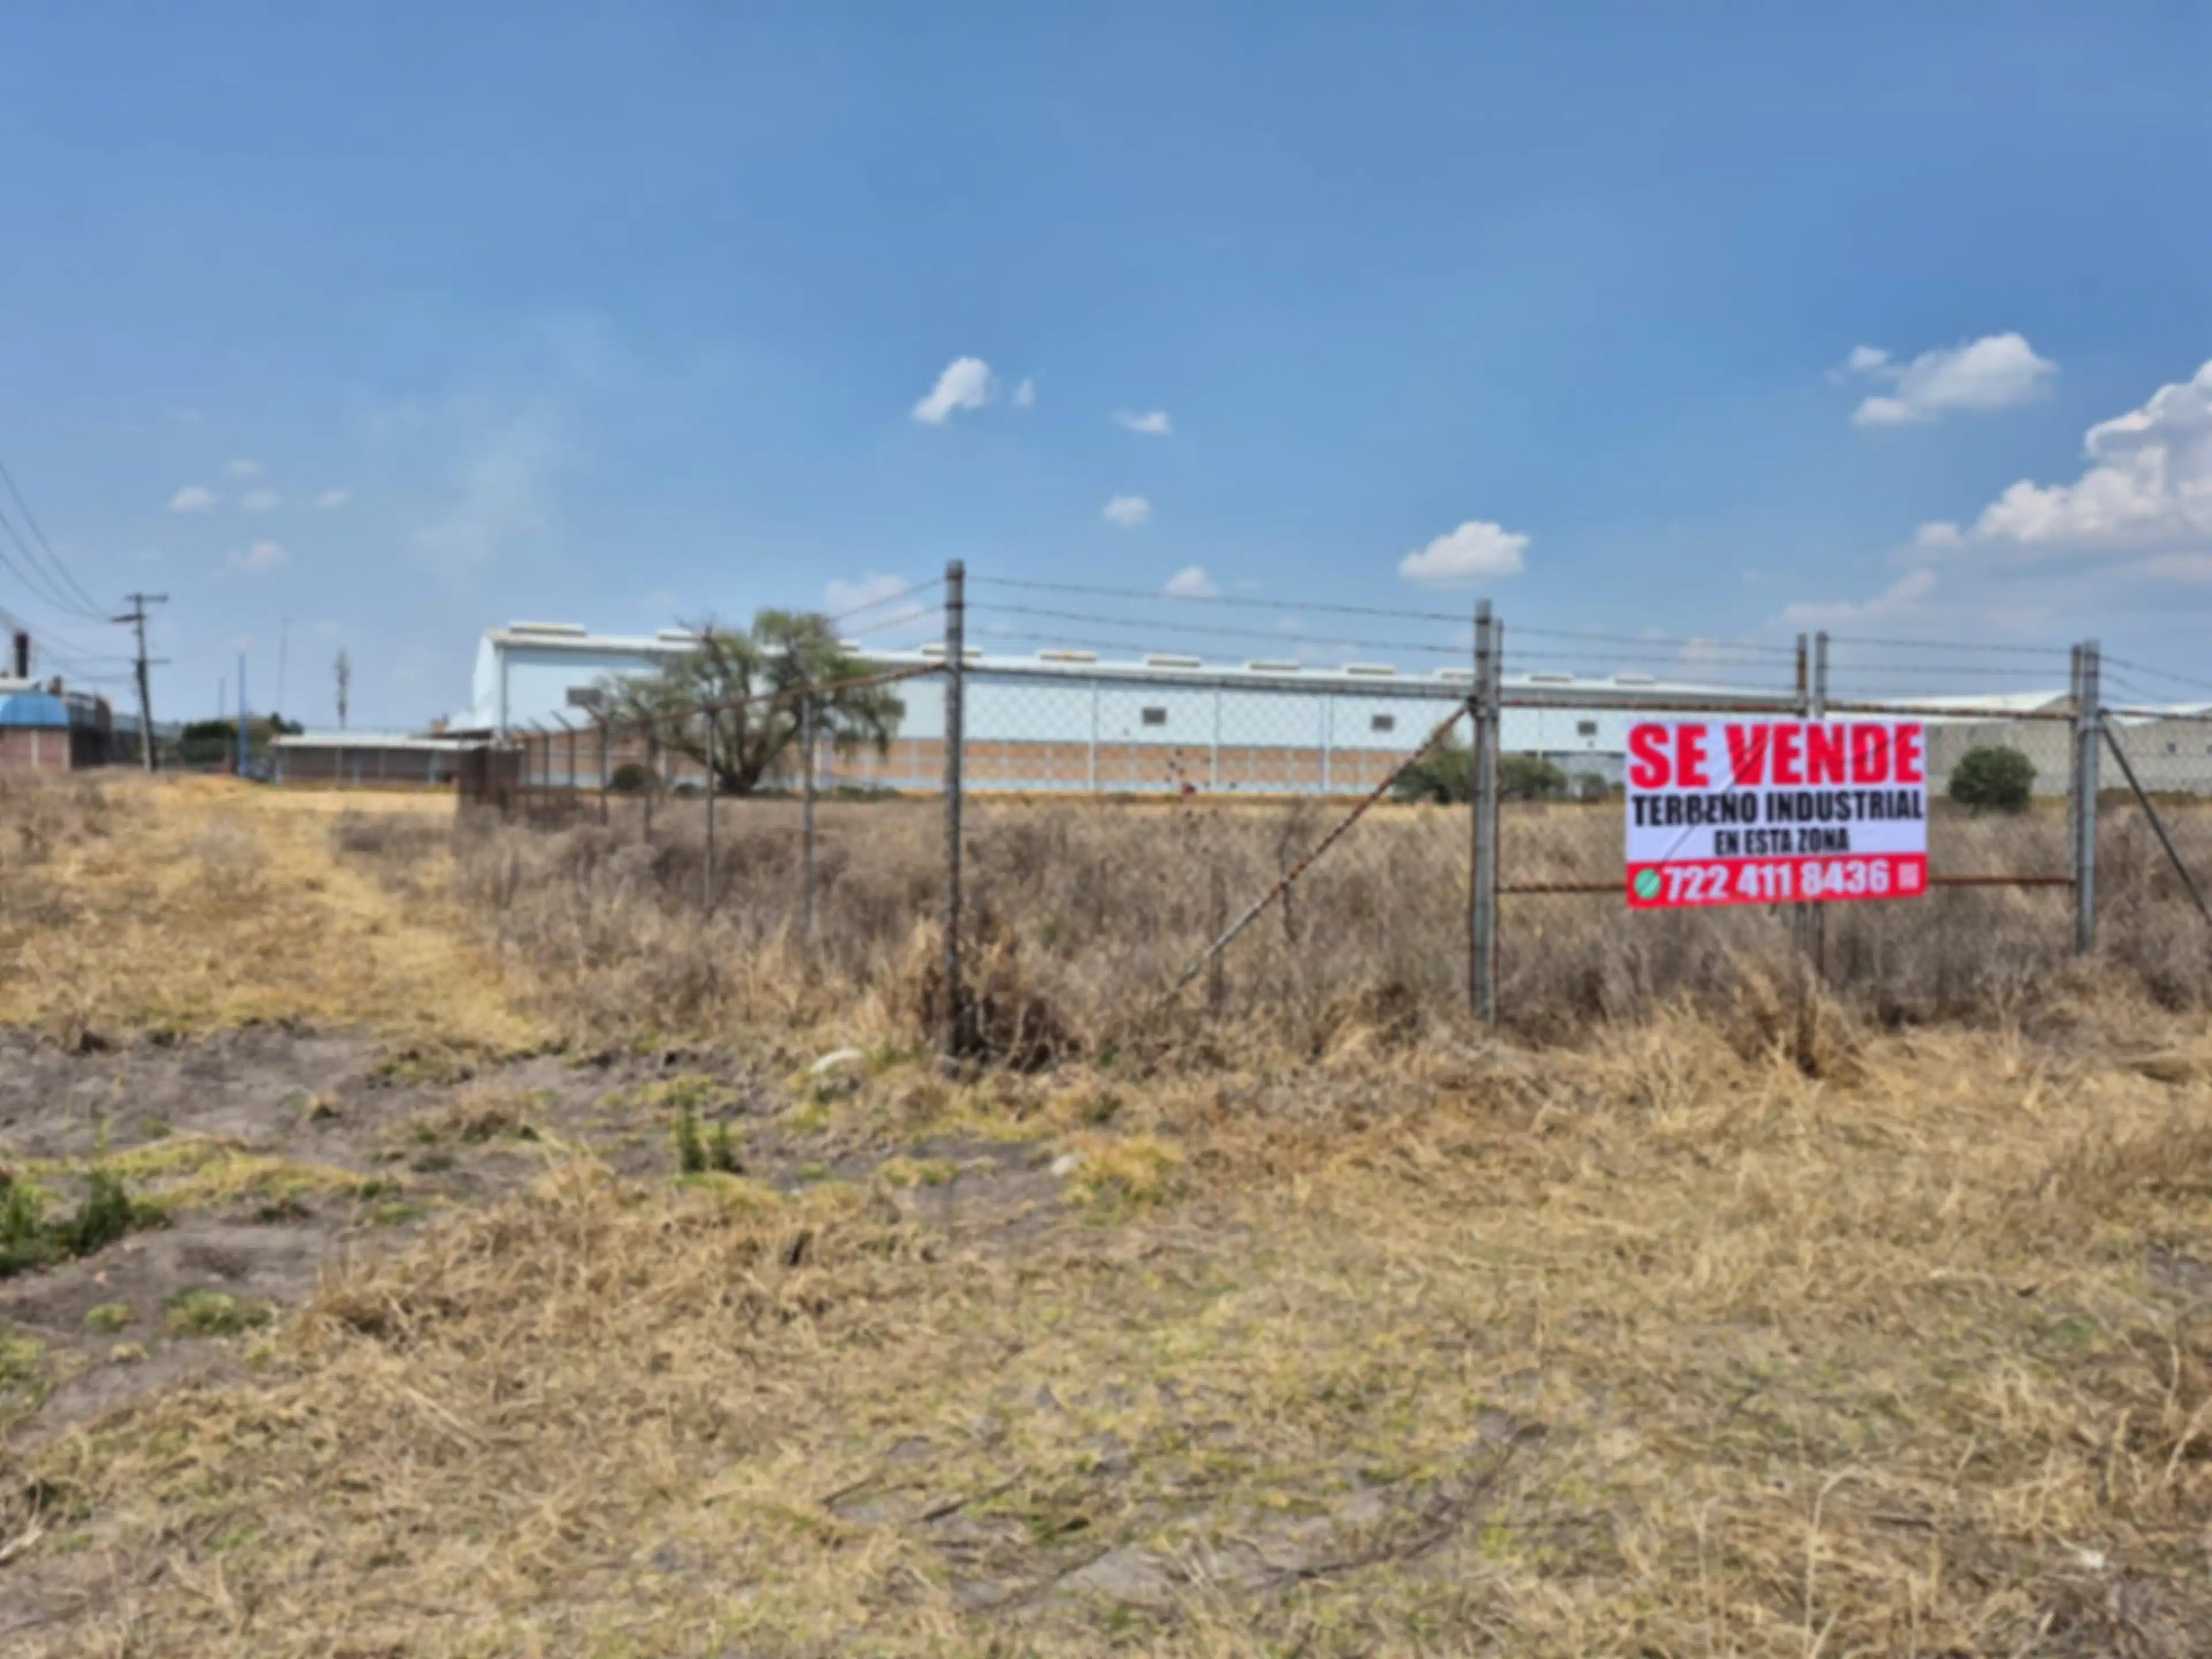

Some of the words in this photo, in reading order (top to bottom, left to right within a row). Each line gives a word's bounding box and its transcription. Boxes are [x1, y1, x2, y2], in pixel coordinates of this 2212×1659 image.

[1629, 724, 1709, 789] SE
[1725, 723, 1922, 786] VENDE
[1767, 790, 1922, 821] INDUSTRIAL
[1715, 830, 1740, 856] EN
[1745, 829, 1793, 854] ESTA
[1798, 828, 1850, 852] ZONA
[1663, 866, 1730, 902] 722
[1737, 863, 1791, 897] 411
[1801, 859, 1889, 895] 8436
